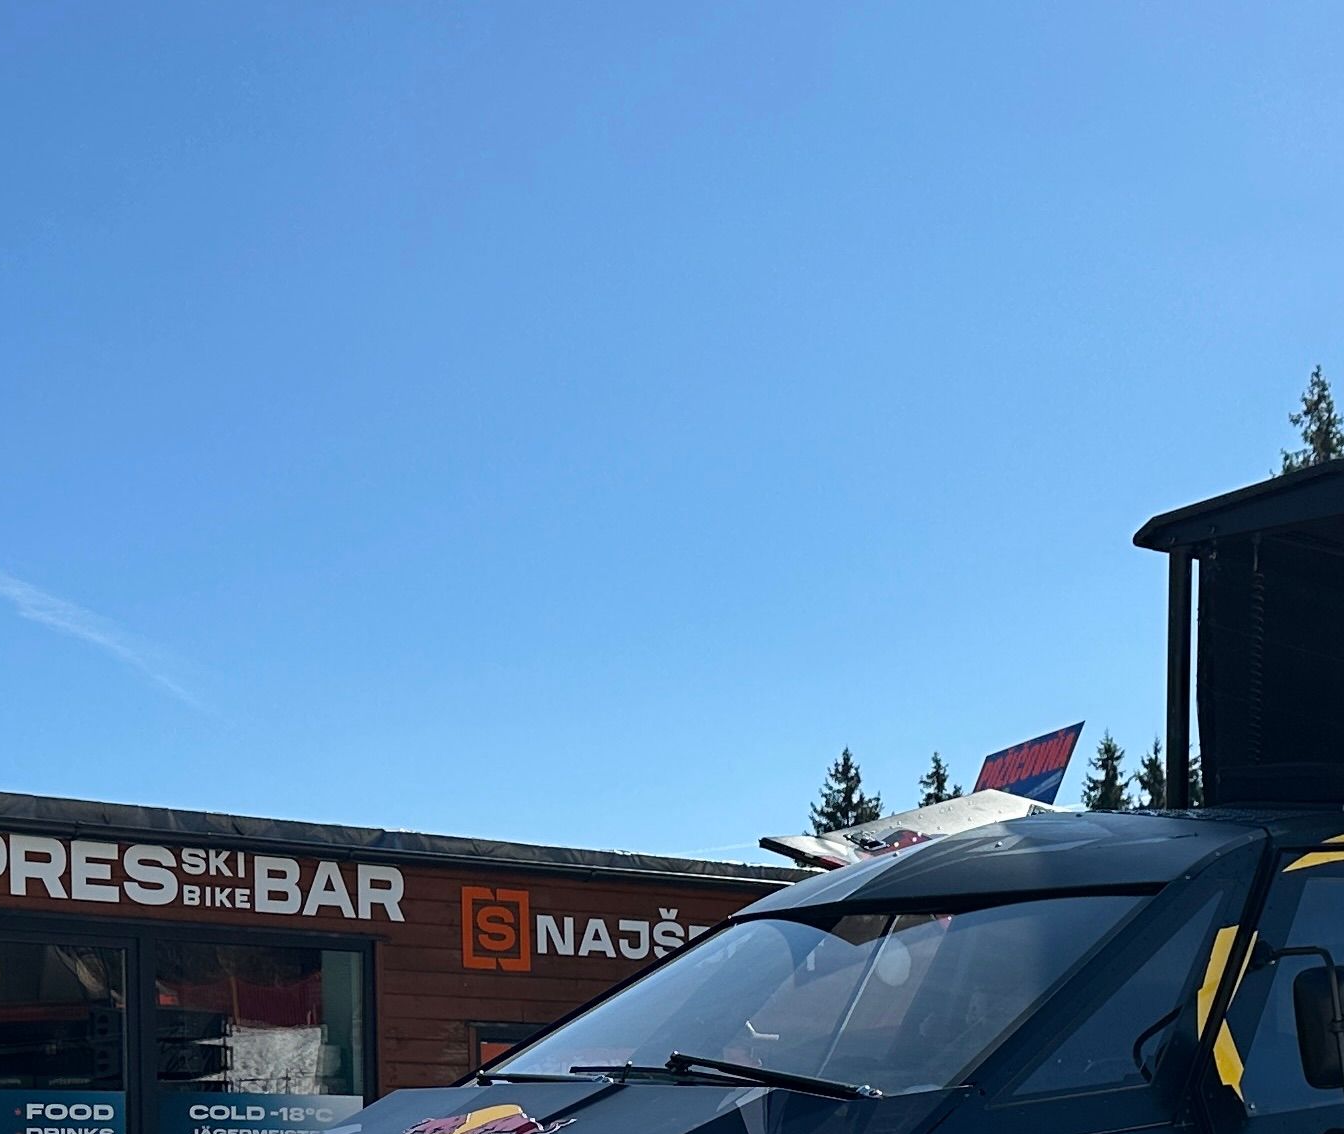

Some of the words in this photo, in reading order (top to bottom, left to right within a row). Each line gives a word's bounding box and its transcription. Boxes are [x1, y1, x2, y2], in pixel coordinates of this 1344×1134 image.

[181, 848, 246, 879] SKI
[183, 884, 251, 909] BIKE
[254, 855, 406, 922] BAR
[26, 1103, 115, 1121] FOOD
[189, 1105, 265, 1122] COLD
[270, 1107, 334, 1123] -18°C
